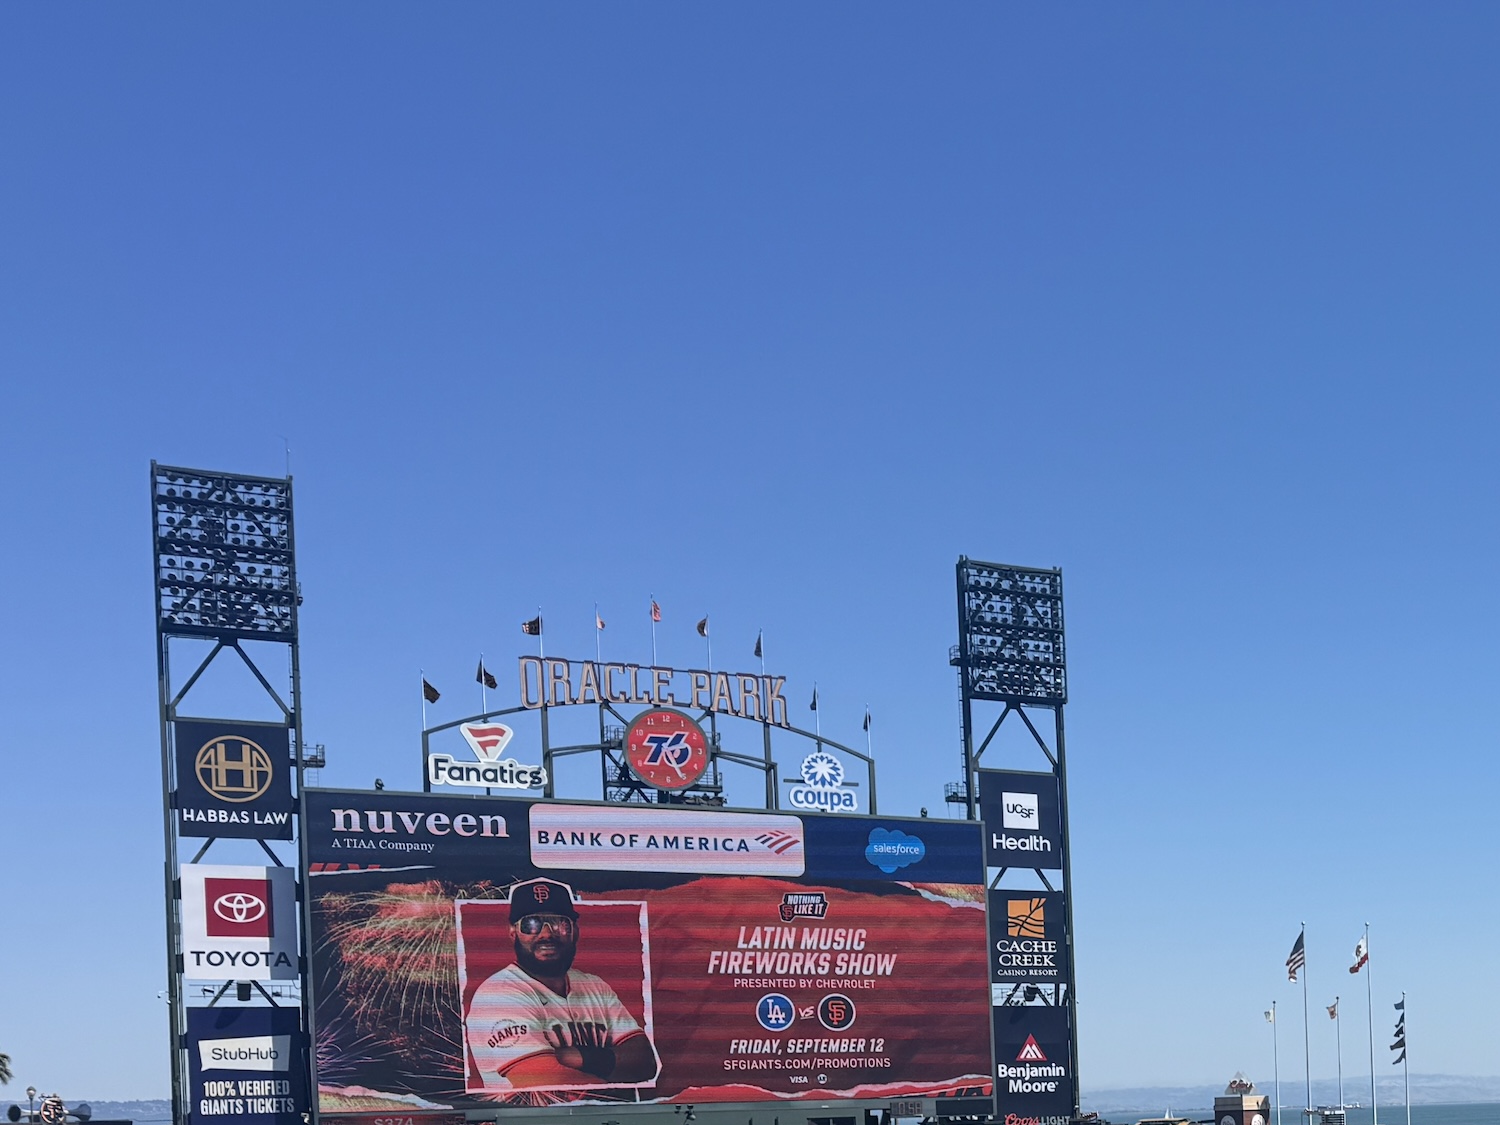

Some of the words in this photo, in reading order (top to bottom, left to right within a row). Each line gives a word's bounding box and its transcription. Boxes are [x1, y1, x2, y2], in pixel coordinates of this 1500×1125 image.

[518, 656, 674, 710] ORACLE
[688, 670, 790, 728] PARK
[642, 731, 692, 768] 76
[433, 758, 543, 786] Fanatics
[793, 788, 854, 810] coupa
[182, 808, 250, 825] HABBAS
[254, 812, 288, 826] LAW
[1006, 804, 1034, 819] UCSF
[331, 808, 510, 838] nuveen
[332, 838, 342, 848] A
[344, 838, 376, 850] TIAA
[379, 840, 434, 854] Company
[538, 830, 602, 848] BANK
[610, 833, 638, 848] OF
[646, 834, 750, 853] AMERICA
[873, 843, 920, 856] salesforce
[992, 834, 1052, 852] Health
[787, 894, 822, 905] NOTHING
[794, 905, 812, 914] LIKE
[814, 904, 824, 914] IT
[737, 926, 796, 950] LATIN
[800, 928, 867, 950] MUSIC
[996, 940, 1056, 953] CACHE
[190, 950, 292, 968] TOYOTA
[708, 951, 832, 975] FIREWORKS
[834, 953, 897, 976] SHOW
[998, 954, 1056, 966] CREEK
[734, 979, 796, 988] PRESENTED
[799, 979, 812, 988] BY
[816, 979, 876, 989] CHEVROLET
[488, 1024, 527, 1049] GIANTS
[211, 1044, 280, 1062] StubHub
[730, 1039, 782, 1055] FRIDAY,
[787, 1038, 866, 1053] SEPTEMBER
[870, 1038, 884, 1052] 12
[724, 1058, 891, 1070] SFGIANTS.COM/PROMOTIONS
[998, 1064, 1065, 1080] Benjamin
[204, 1080, 236, 1098] 100%
[238, 1080, 290, 1097] VERIFIED
[790, 1076, 808, 1084] VISA
[1009, 1080, 1056, 1093] Moore
[200, 1098, 244, 1116] GIANTS
[246, 1098, 295, 1114] TICKETS
[1041, 1116, 1070, 1125] LIGHT
